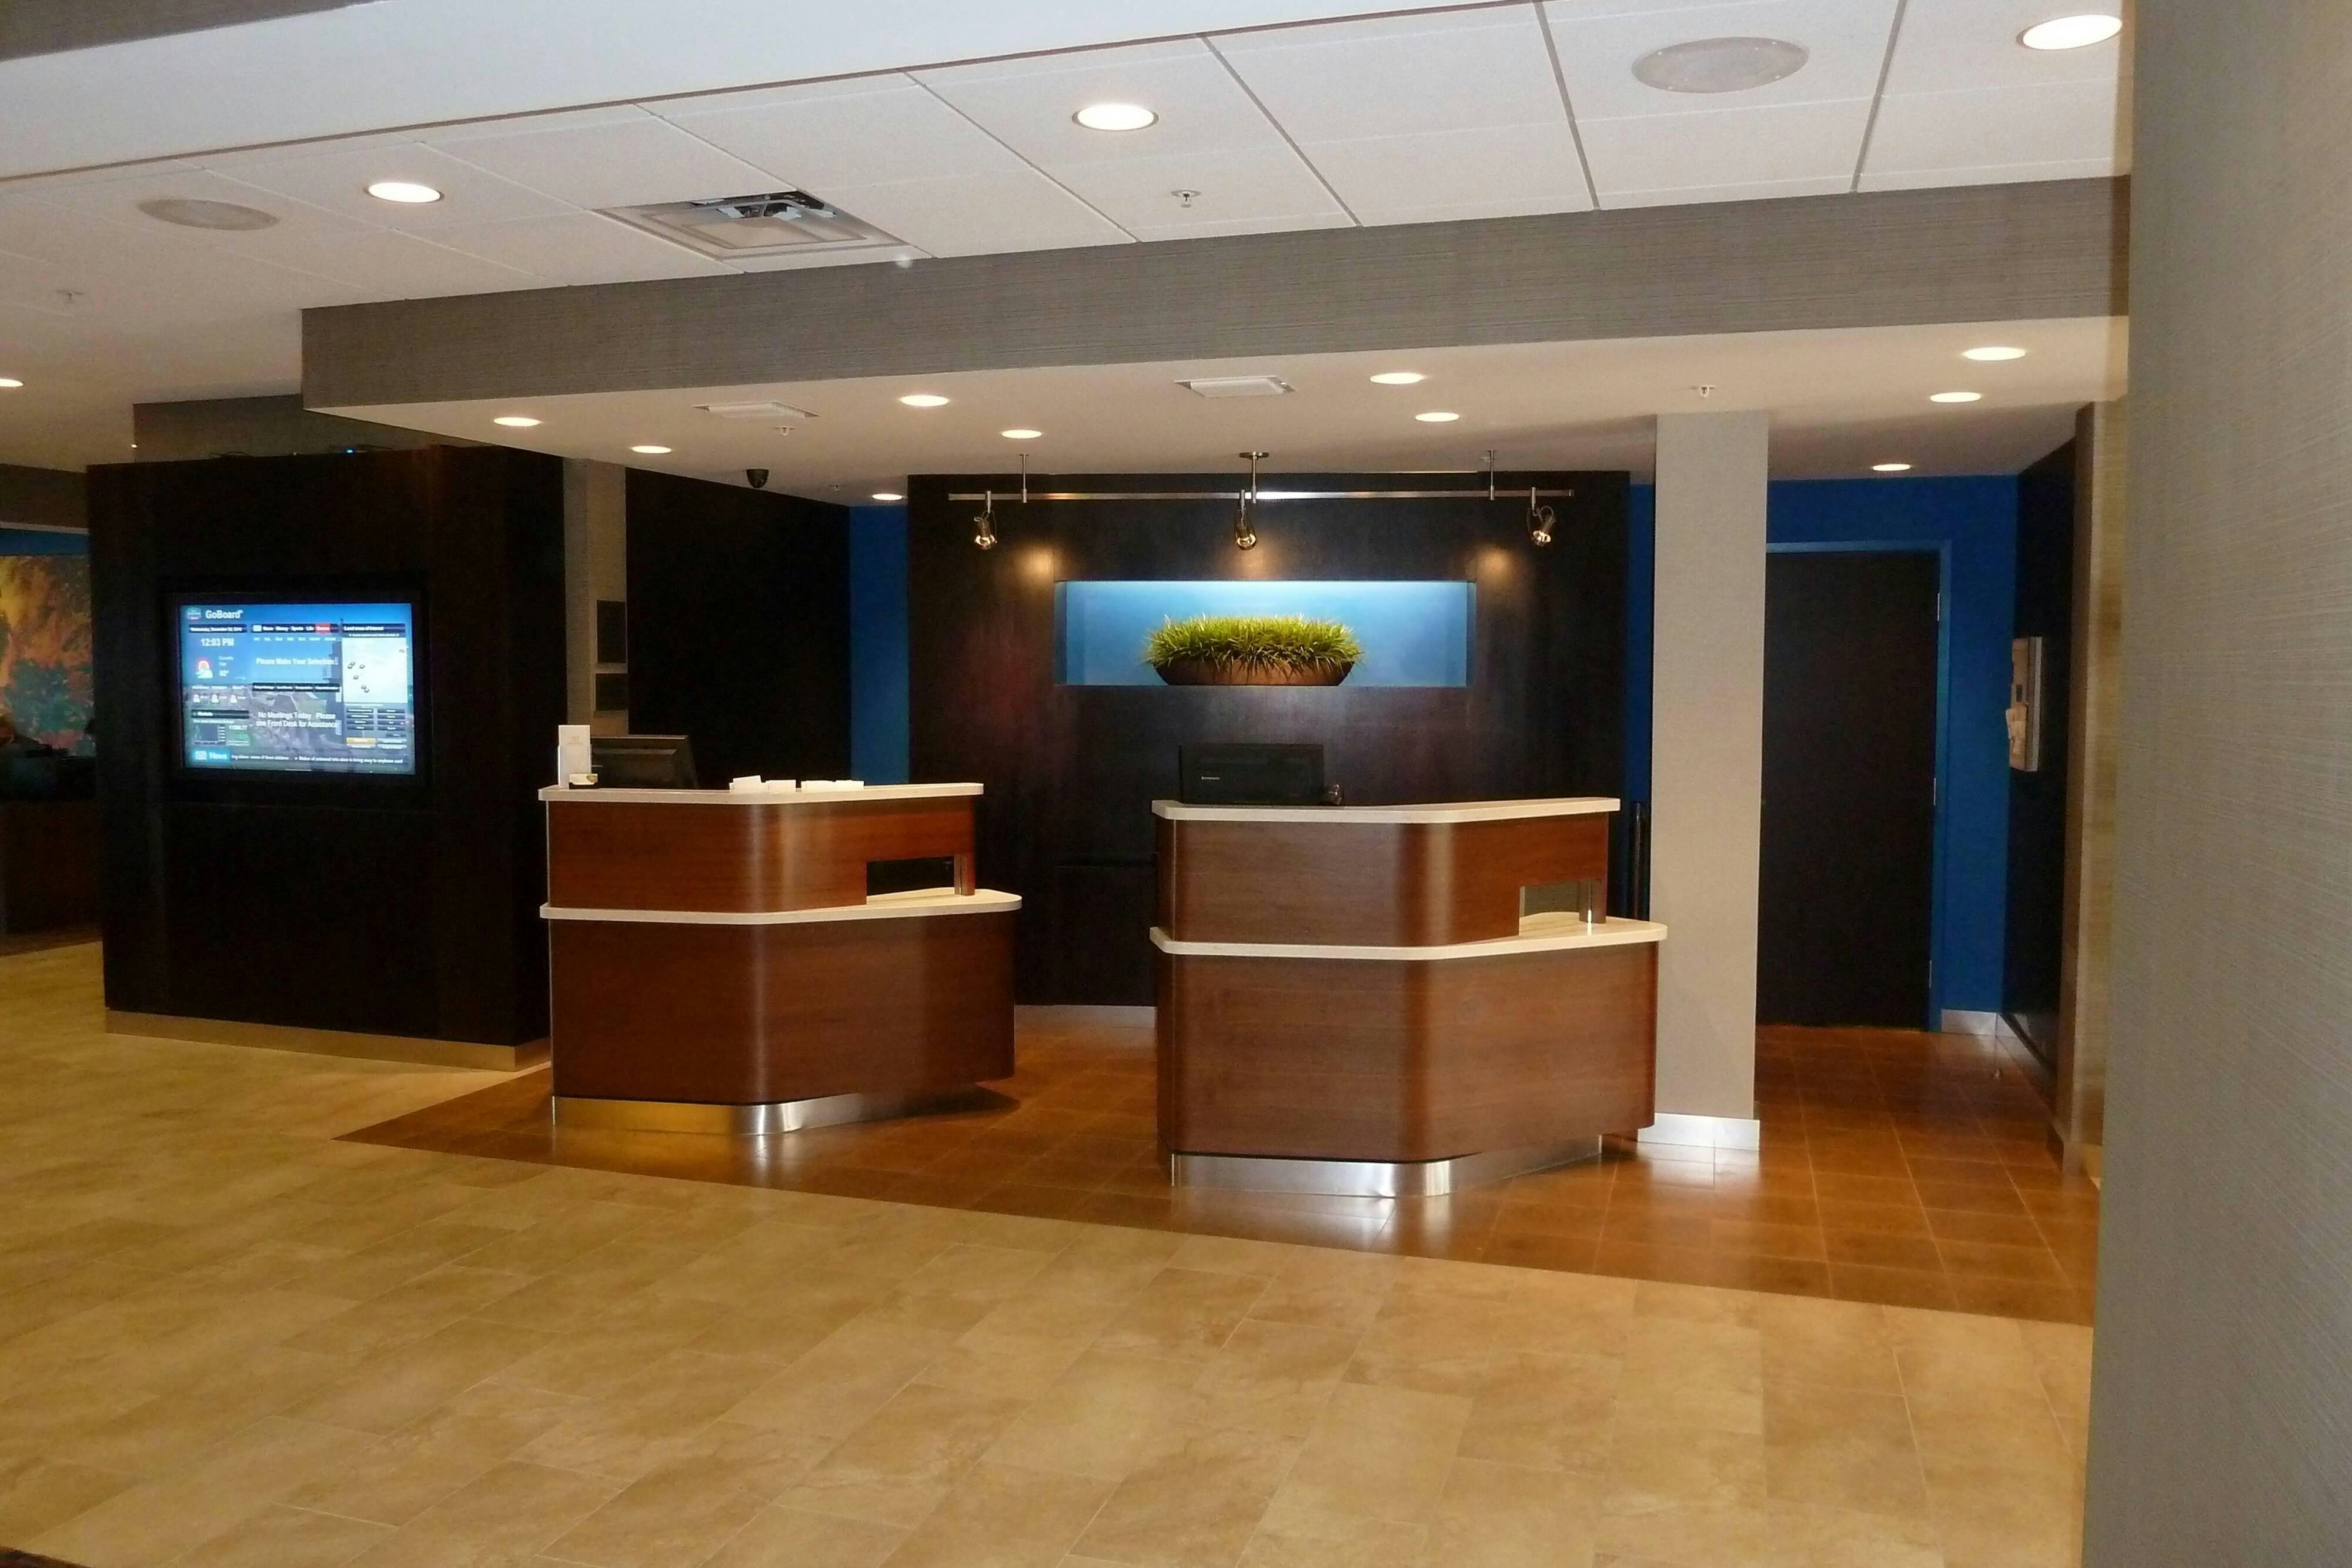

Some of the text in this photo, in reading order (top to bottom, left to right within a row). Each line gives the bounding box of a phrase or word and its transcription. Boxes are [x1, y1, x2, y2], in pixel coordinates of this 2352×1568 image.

[201, 637, 235, 646] 12:03 PM
[267, 711, 292, 720] Meetings
